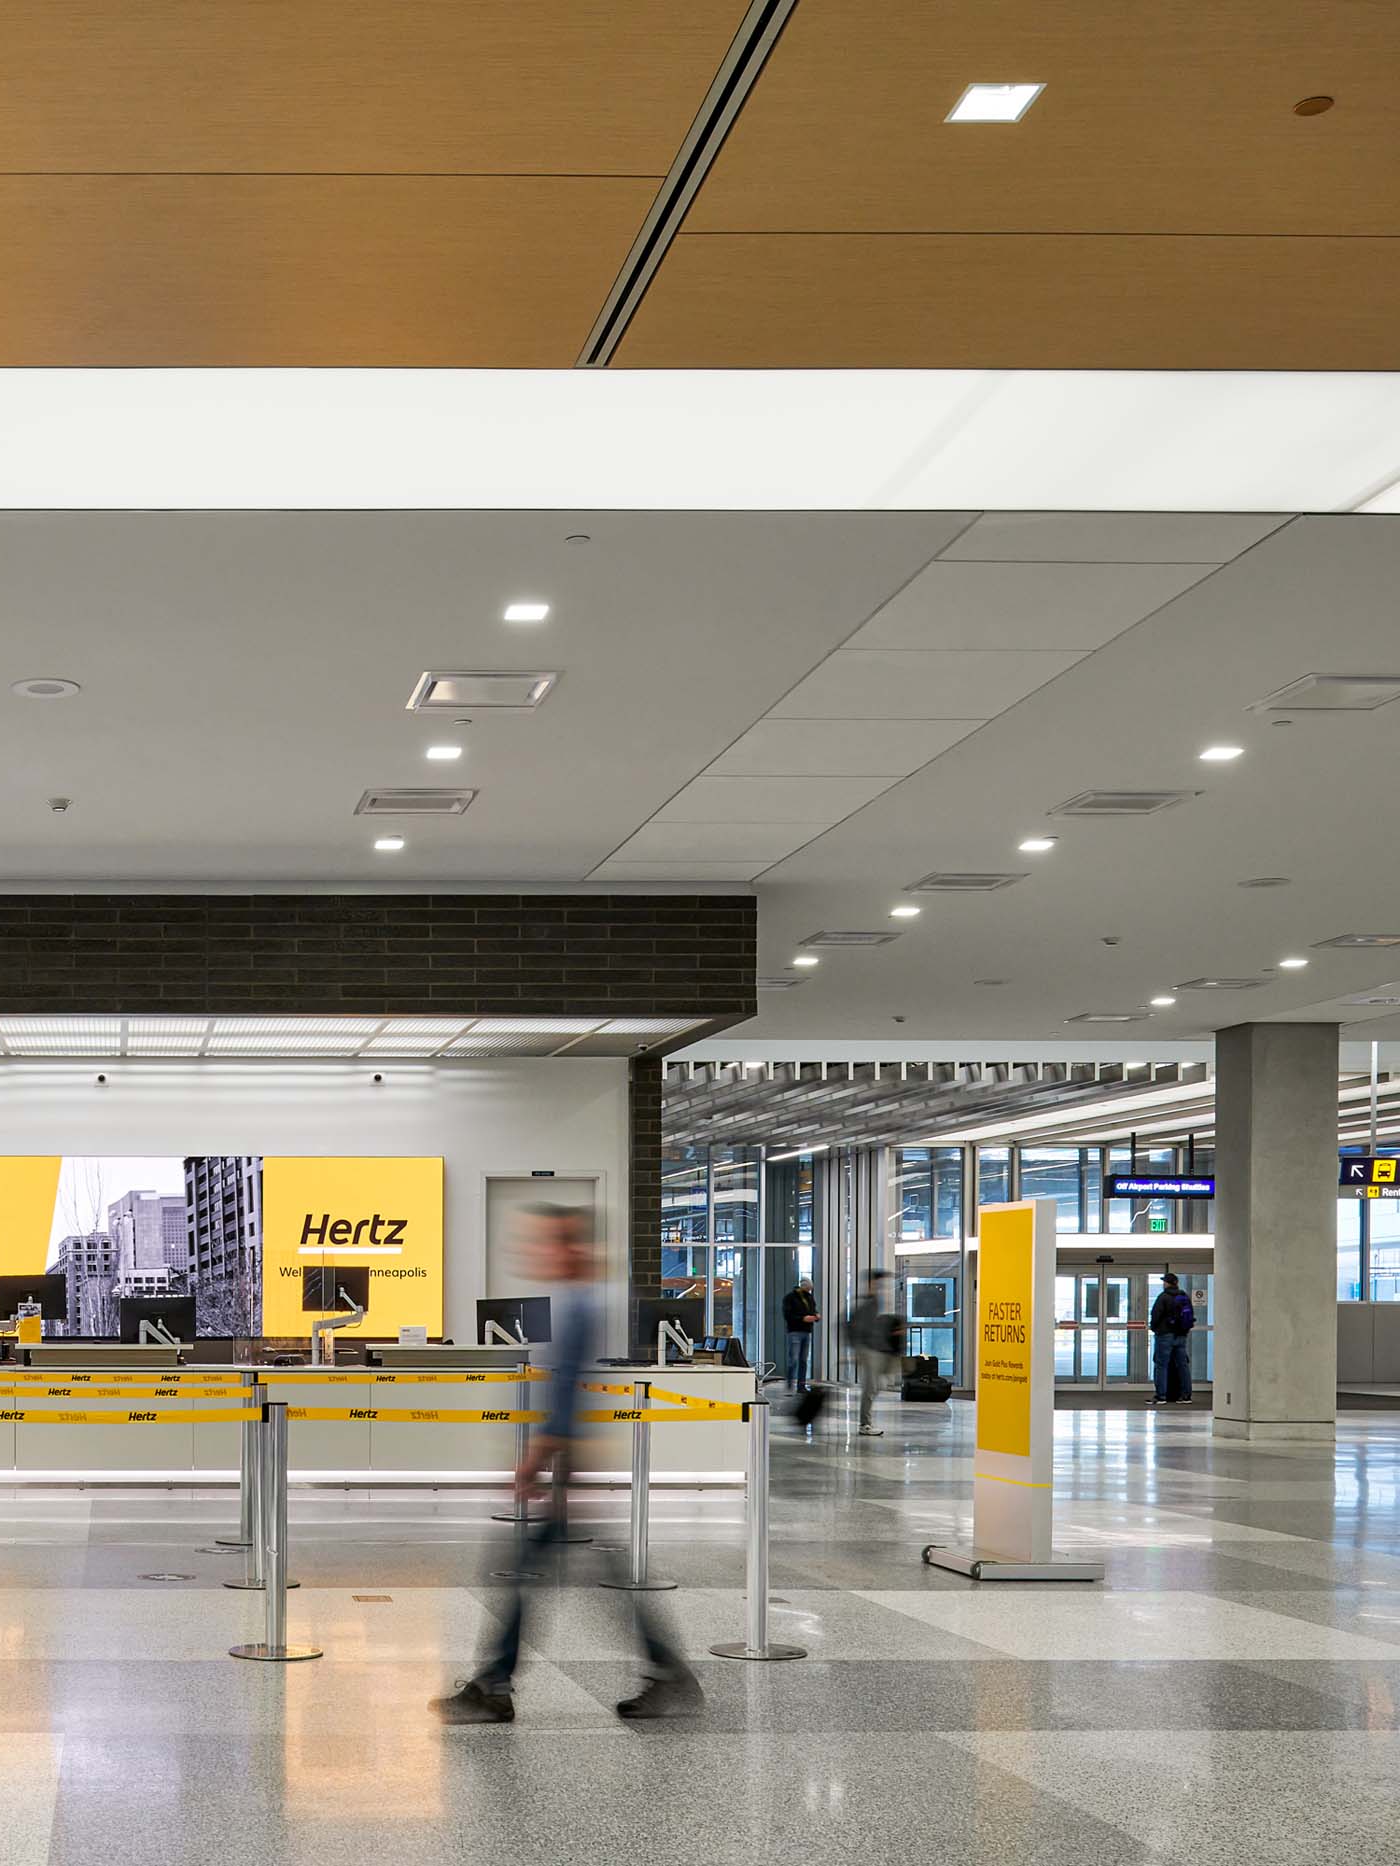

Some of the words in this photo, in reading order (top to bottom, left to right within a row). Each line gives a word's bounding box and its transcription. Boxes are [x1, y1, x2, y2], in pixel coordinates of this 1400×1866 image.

[1116, 1182, 1128, 1191] Off
[1128, 1182, 1153, 1192] Airport
[1154, 1182, 1180, 1192] Parking
[1181, 1183, 1210, 1191] Shuttles
[300, 1214, 408, 1245] Hertz
[1151, 1219, 1166, 1231] EXIT
[369, 1267, 428, 1280] nneapolis
[988, 1302, 1022, 1321] FASTER
[984, 1324, 1026, 1344] RETURNS
[466, 1374, 486, 1382] Hertz
[48, 1388, 72, 1396] Hertz
[154, 1388, 178, 1397] Hertz
[128, 1412, 157, 1422] Hertz
[349, 1409, 378, 1419] Hertz
[481, 1411, 510, 1421] Hertz
[613, 1410, 642, 1420] Hertz
